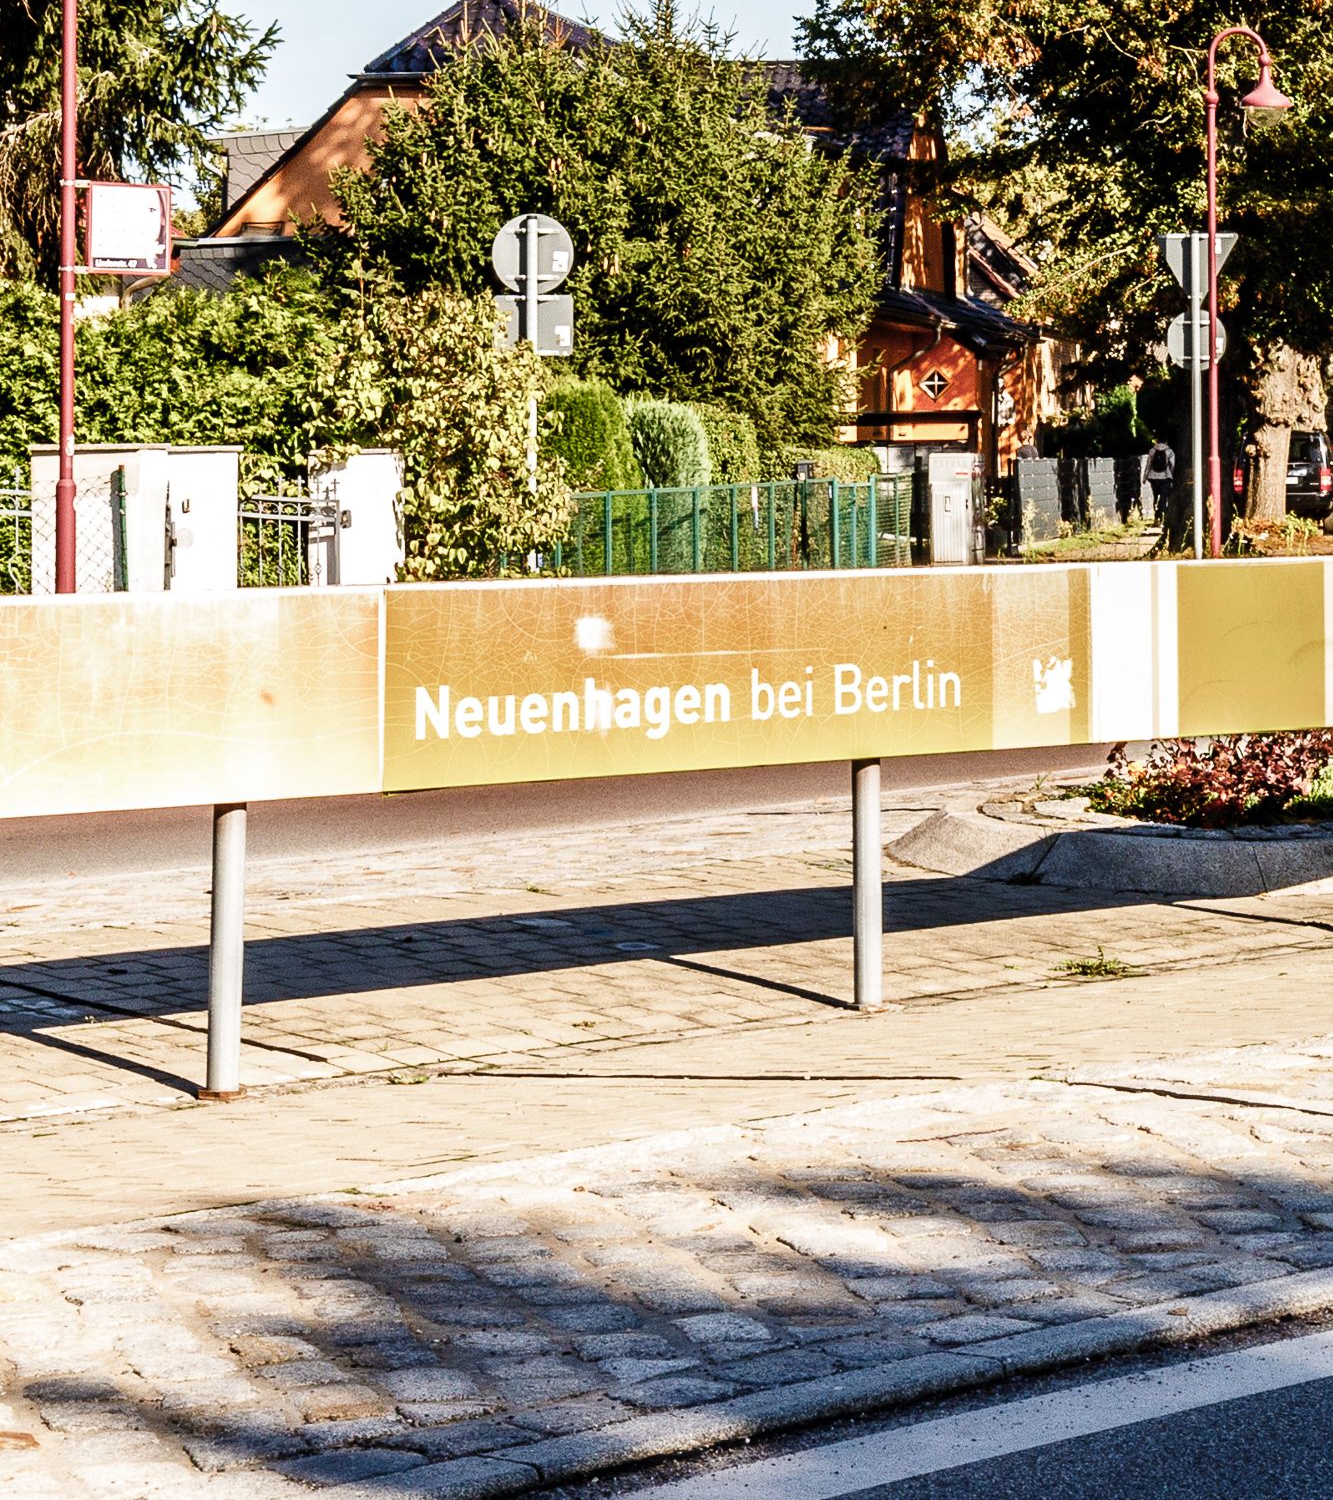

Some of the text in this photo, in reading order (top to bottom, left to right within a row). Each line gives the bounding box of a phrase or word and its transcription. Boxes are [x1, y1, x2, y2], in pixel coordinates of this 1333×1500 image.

[413, 659, 962, 742] Neuenhagen bei Berlin
